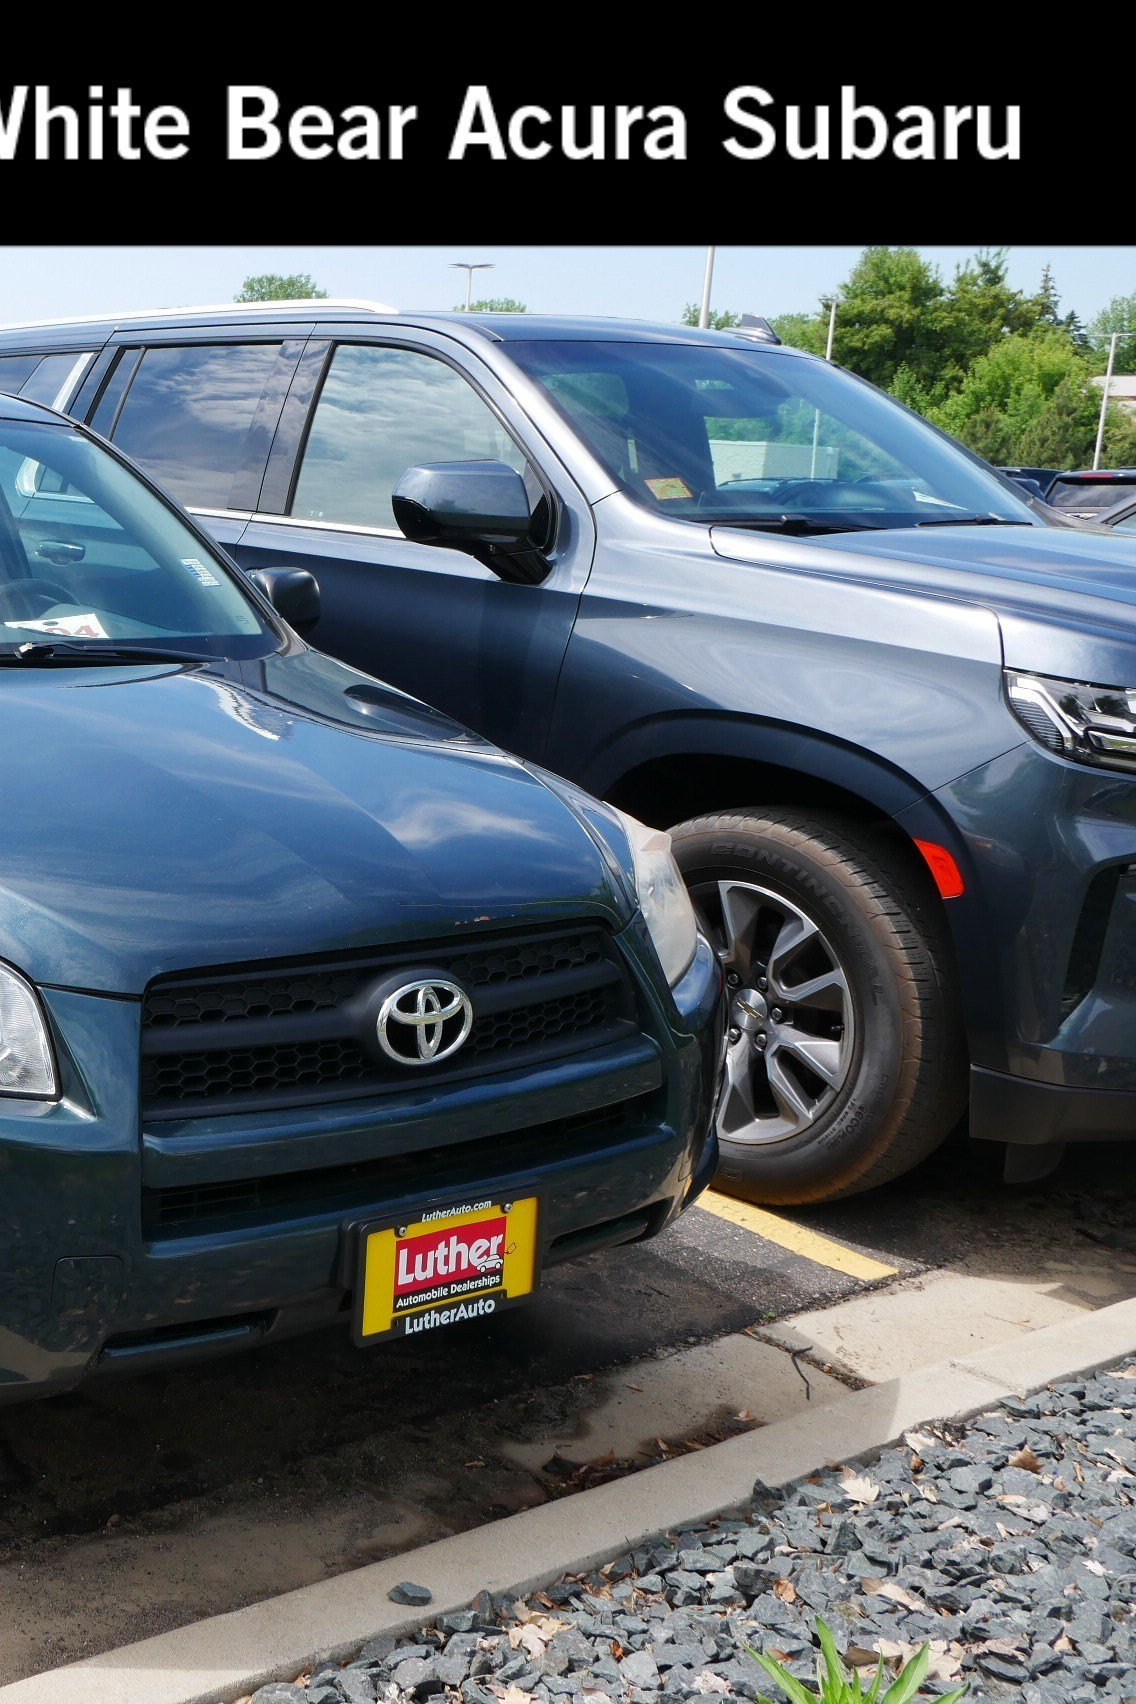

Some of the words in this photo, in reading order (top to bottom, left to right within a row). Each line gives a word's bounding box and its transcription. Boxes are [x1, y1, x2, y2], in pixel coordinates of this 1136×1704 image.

[421, 1200, 492, 1223] LutherAuto.com
[397, 1233, 504, 1286] Luther
[396, 1286, 449, 1309] Automobile
[450, 1274, 501, 1295] Dealerships
[405, 1299, 496, 1335] LutherAuto
